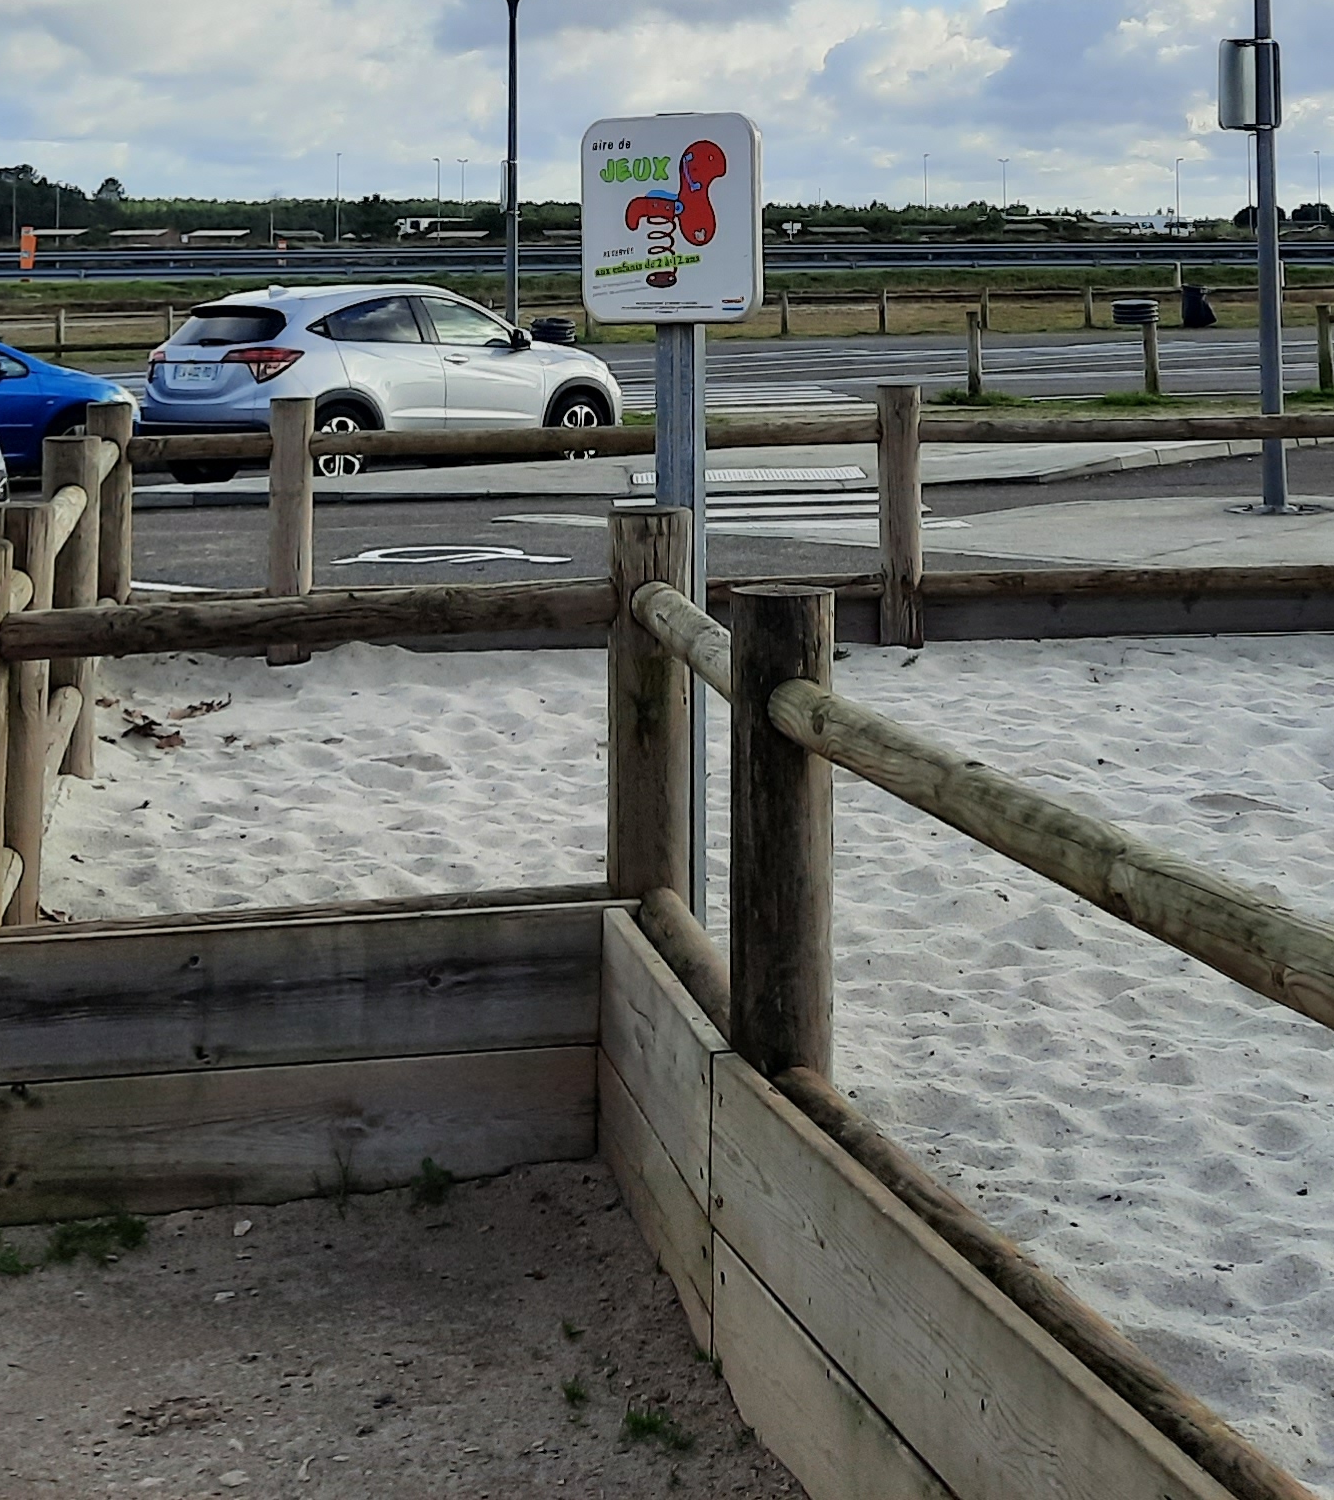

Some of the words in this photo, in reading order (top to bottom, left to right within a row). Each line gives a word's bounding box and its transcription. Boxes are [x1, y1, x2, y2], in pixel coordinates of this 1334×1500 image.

[592, 139, 614, 151] aire
[618, 137, 632, 150] de
[599, 156, 671, 183] JEUX
